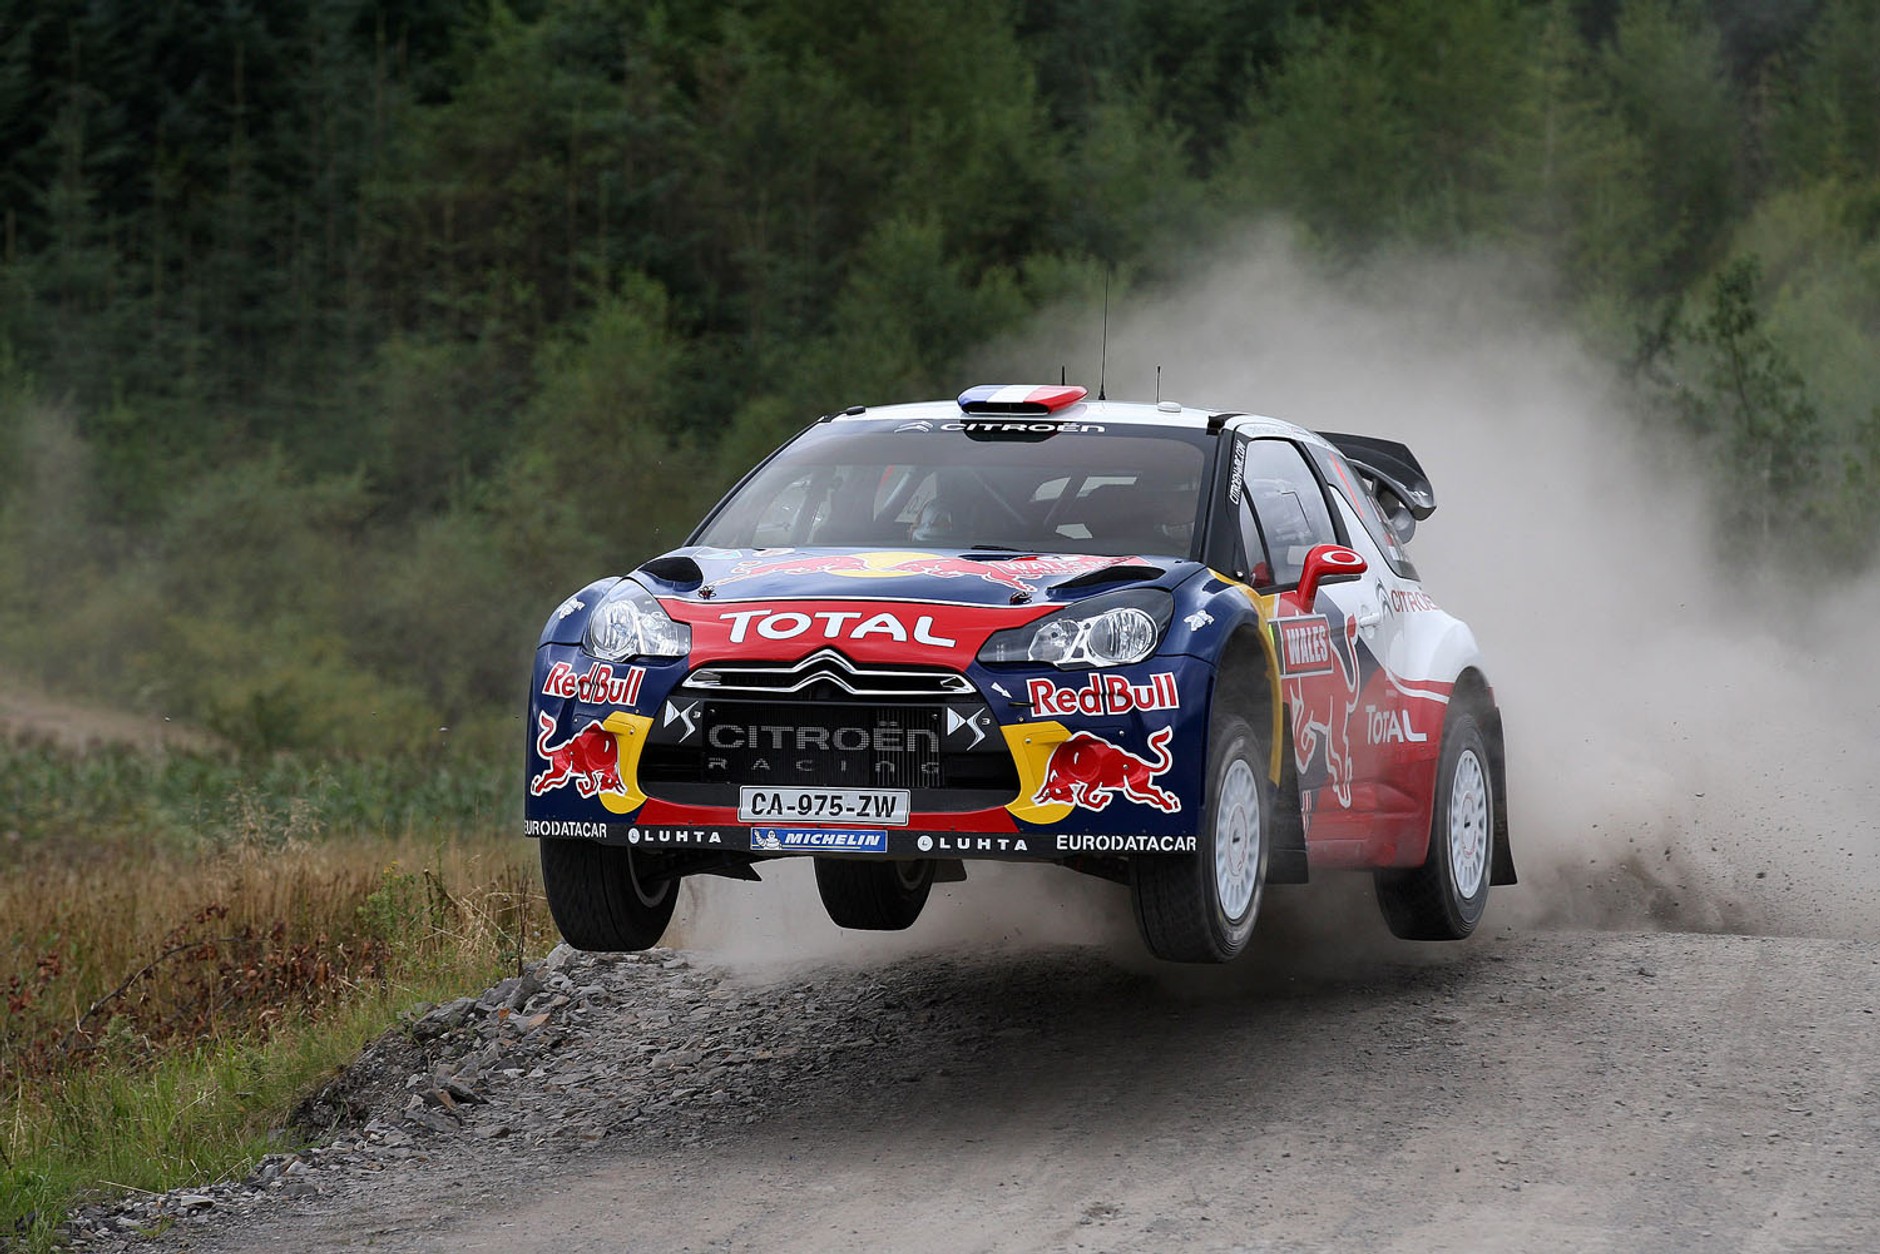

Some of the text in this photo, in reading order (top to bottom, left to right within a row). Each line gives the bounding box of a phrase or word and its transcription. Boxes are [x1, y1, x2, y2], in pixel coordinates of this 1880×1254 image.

[718, 608, 957, 648] TOTAL
[1285, 625, 1329, 665] WALES
[1365, 705, 1427, 745] TOTAL
[751, 792, 897, 818] CA-975-ZW
[644, 830, 722, 844] LUHTA
[784, 833, 881, 846] MICHELIN
[939, 837, 1028, 851] LUHTA
[1056, 835, 1197, 851] EURODATACAR
